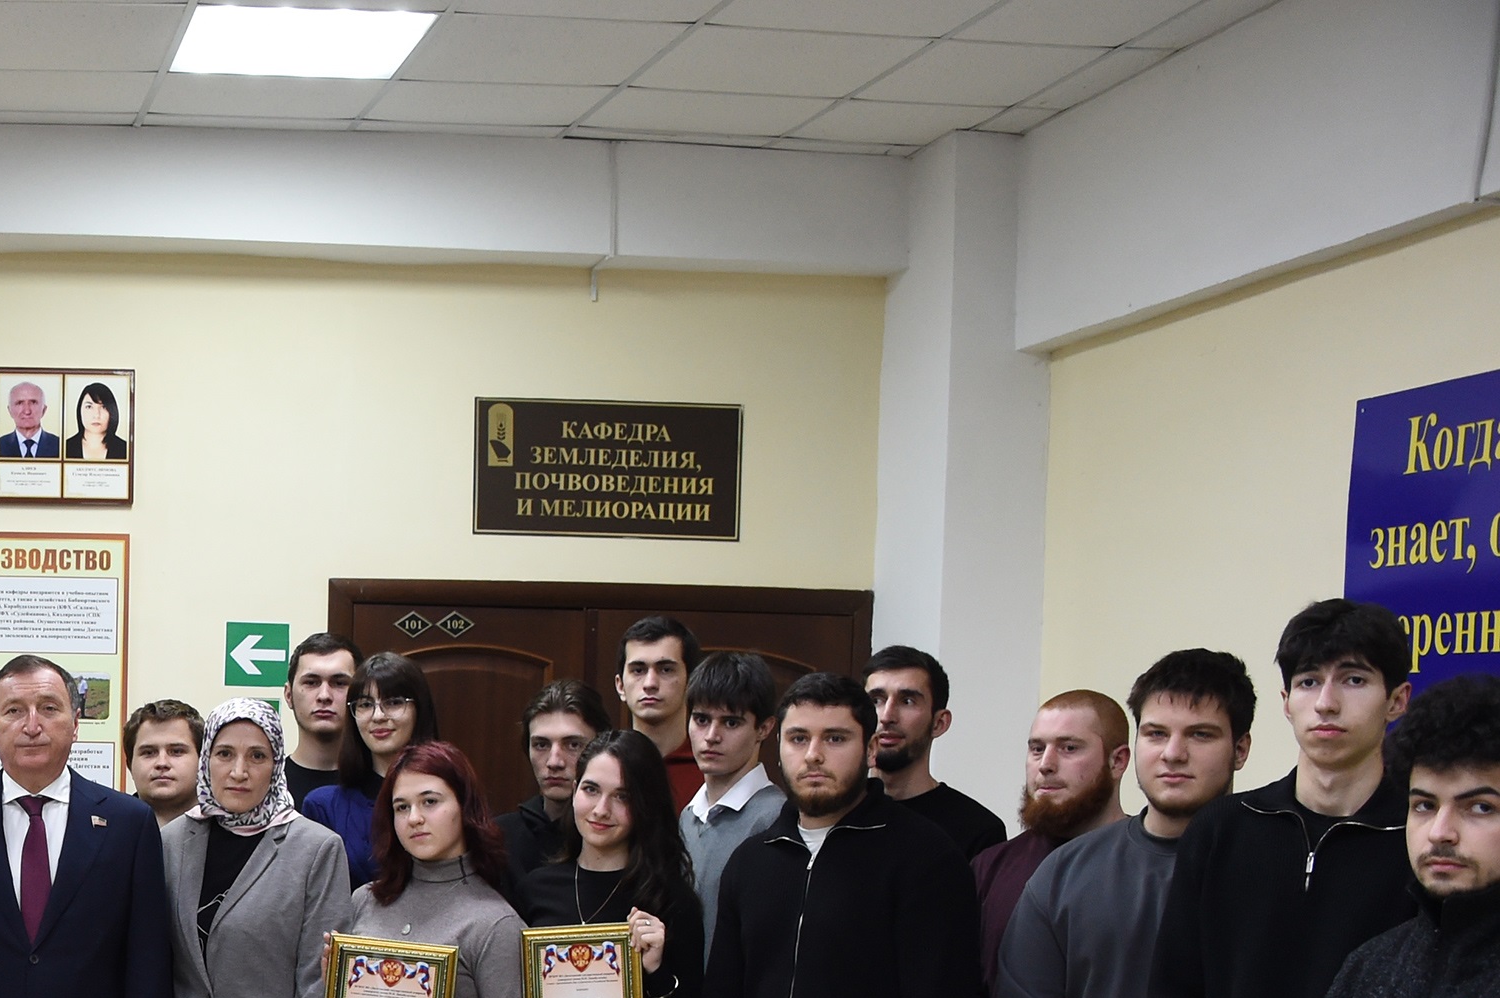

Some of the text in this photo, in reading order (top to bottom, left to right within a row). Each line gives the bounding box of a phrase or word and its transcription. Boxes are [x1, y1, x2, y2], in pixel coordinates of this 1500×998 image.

[561, 421, 671, 443] КАФЕДРА
[530, 446, 702, 472] ЗЕМЛЕДЕЛИЯ,
[514, 472, 714, 496] ПОЧВОВЕДЕНИЯ
[516, 498, 710, 524] И МЕЛИОРАЦИИ
[1369, 517, 1477, 573] знает,
[404, 619, 422, 630] 101
[446, 619, 465, 630] 102
